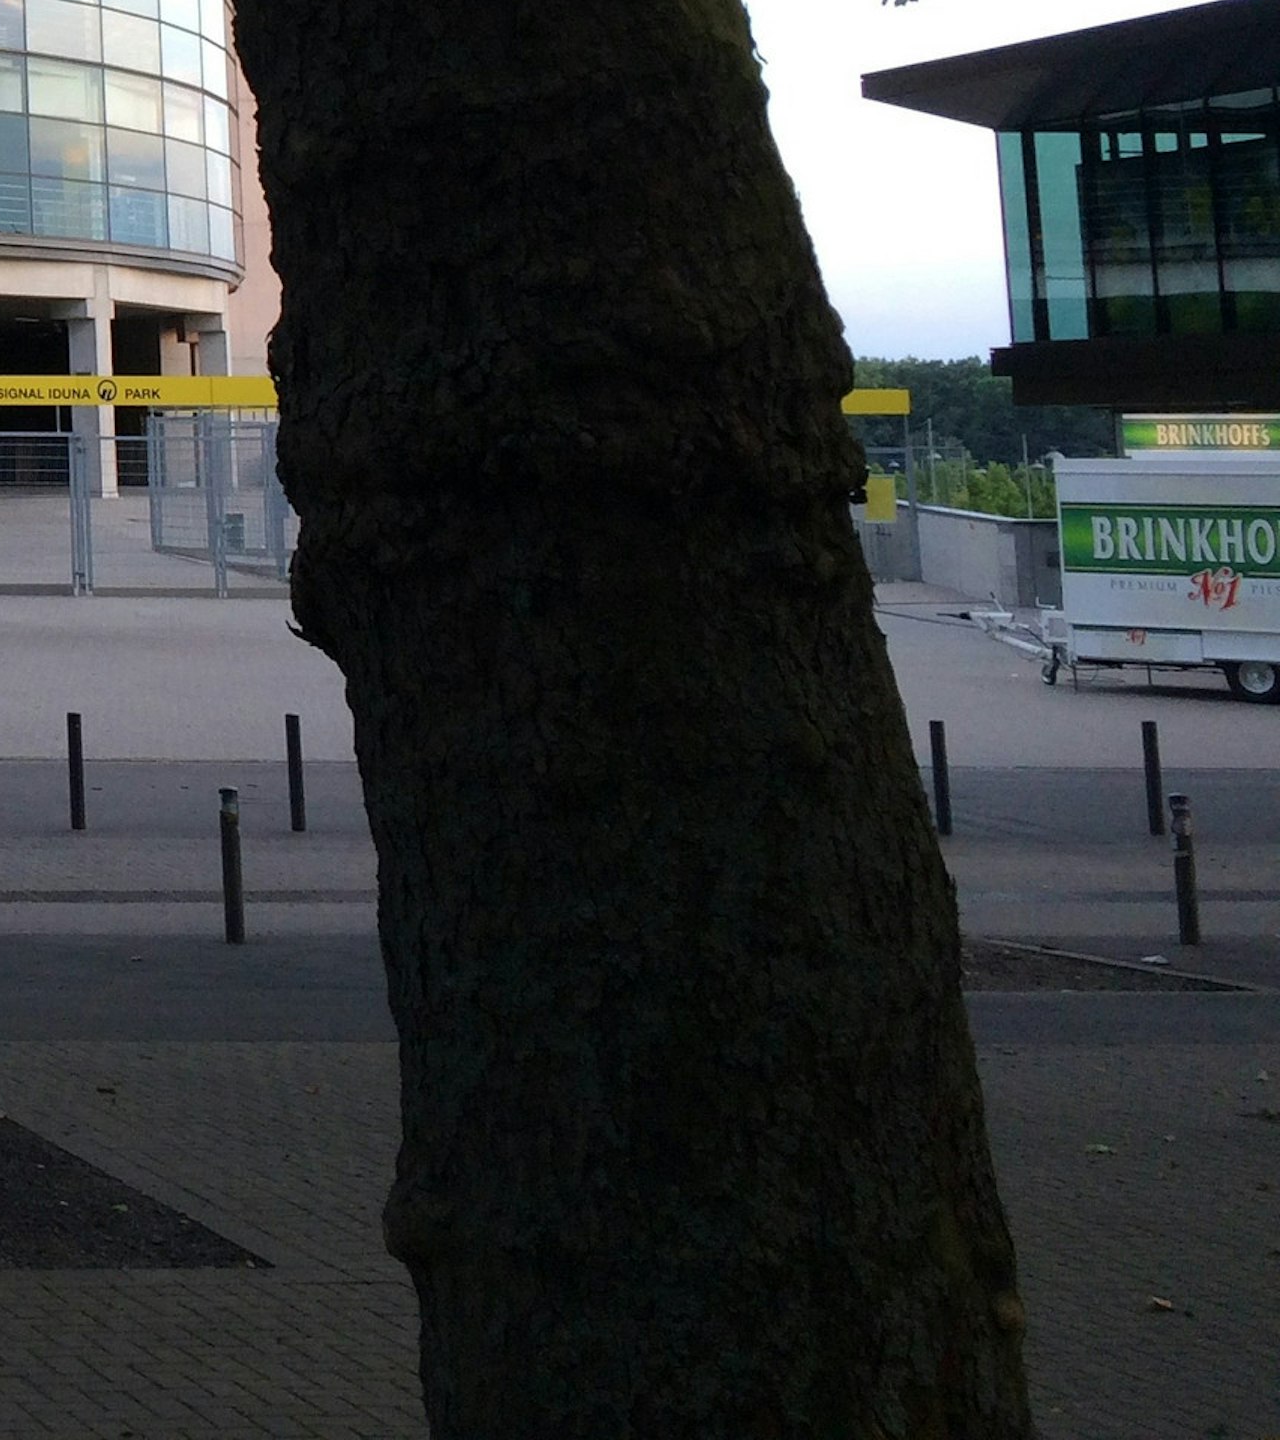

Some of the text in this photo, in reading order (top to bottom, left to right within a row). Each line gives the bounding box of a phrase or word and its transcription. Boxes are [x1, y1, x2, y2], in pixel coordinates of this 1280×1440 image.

[48, 387, 90, 400] IDUNA
[124, 387, 161, 400] PARK
[1156, 423, 1271, 447] BRINKHOFF's
[1091, 515, 1280, 566] BRINKHO
[1110, 578, 1178, 592] PREMIUM
